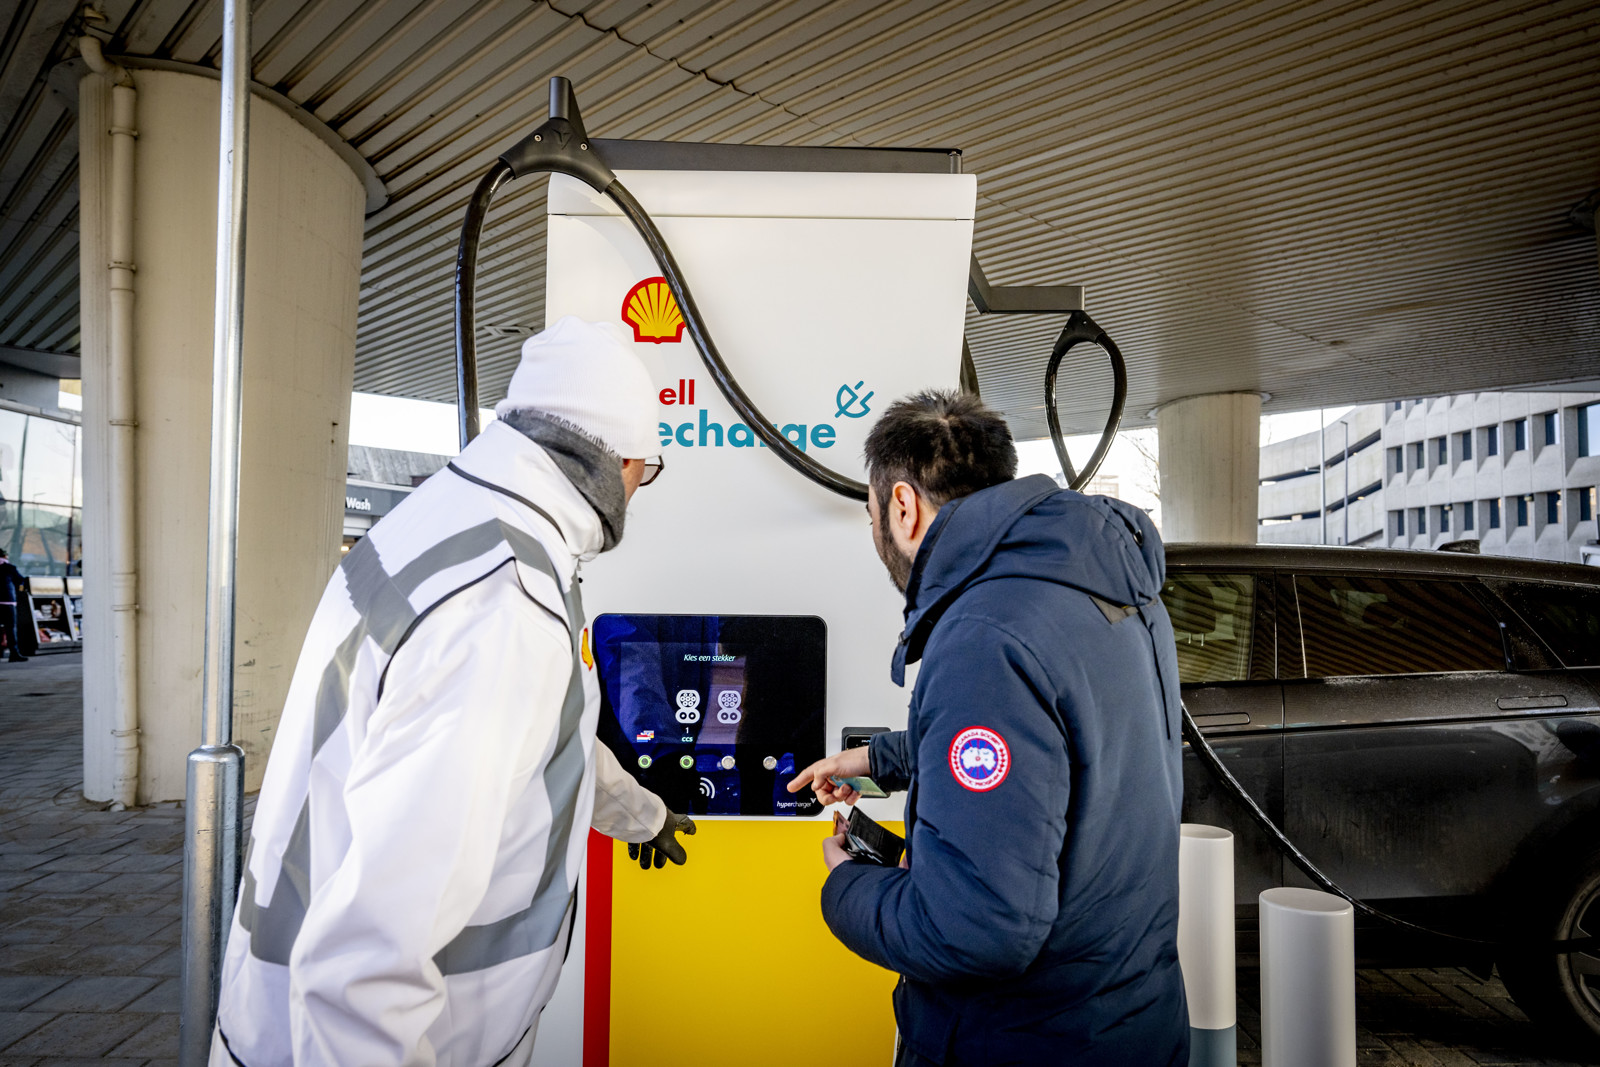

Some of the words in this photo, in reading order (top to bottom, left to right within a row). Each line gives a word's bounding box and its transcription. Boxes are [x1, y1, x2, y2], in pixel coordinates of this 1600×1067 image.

[658, 379, 695, 405] ell
[658, 409, 836, 452] echage
[346, 496, 371, 511] Wash
[683, 653, 698, 662] Kies
[712, 654, 736, 662] stekker
[685, 726, 689, 734] 1
[776, 800, 812, 809] hypercharger
